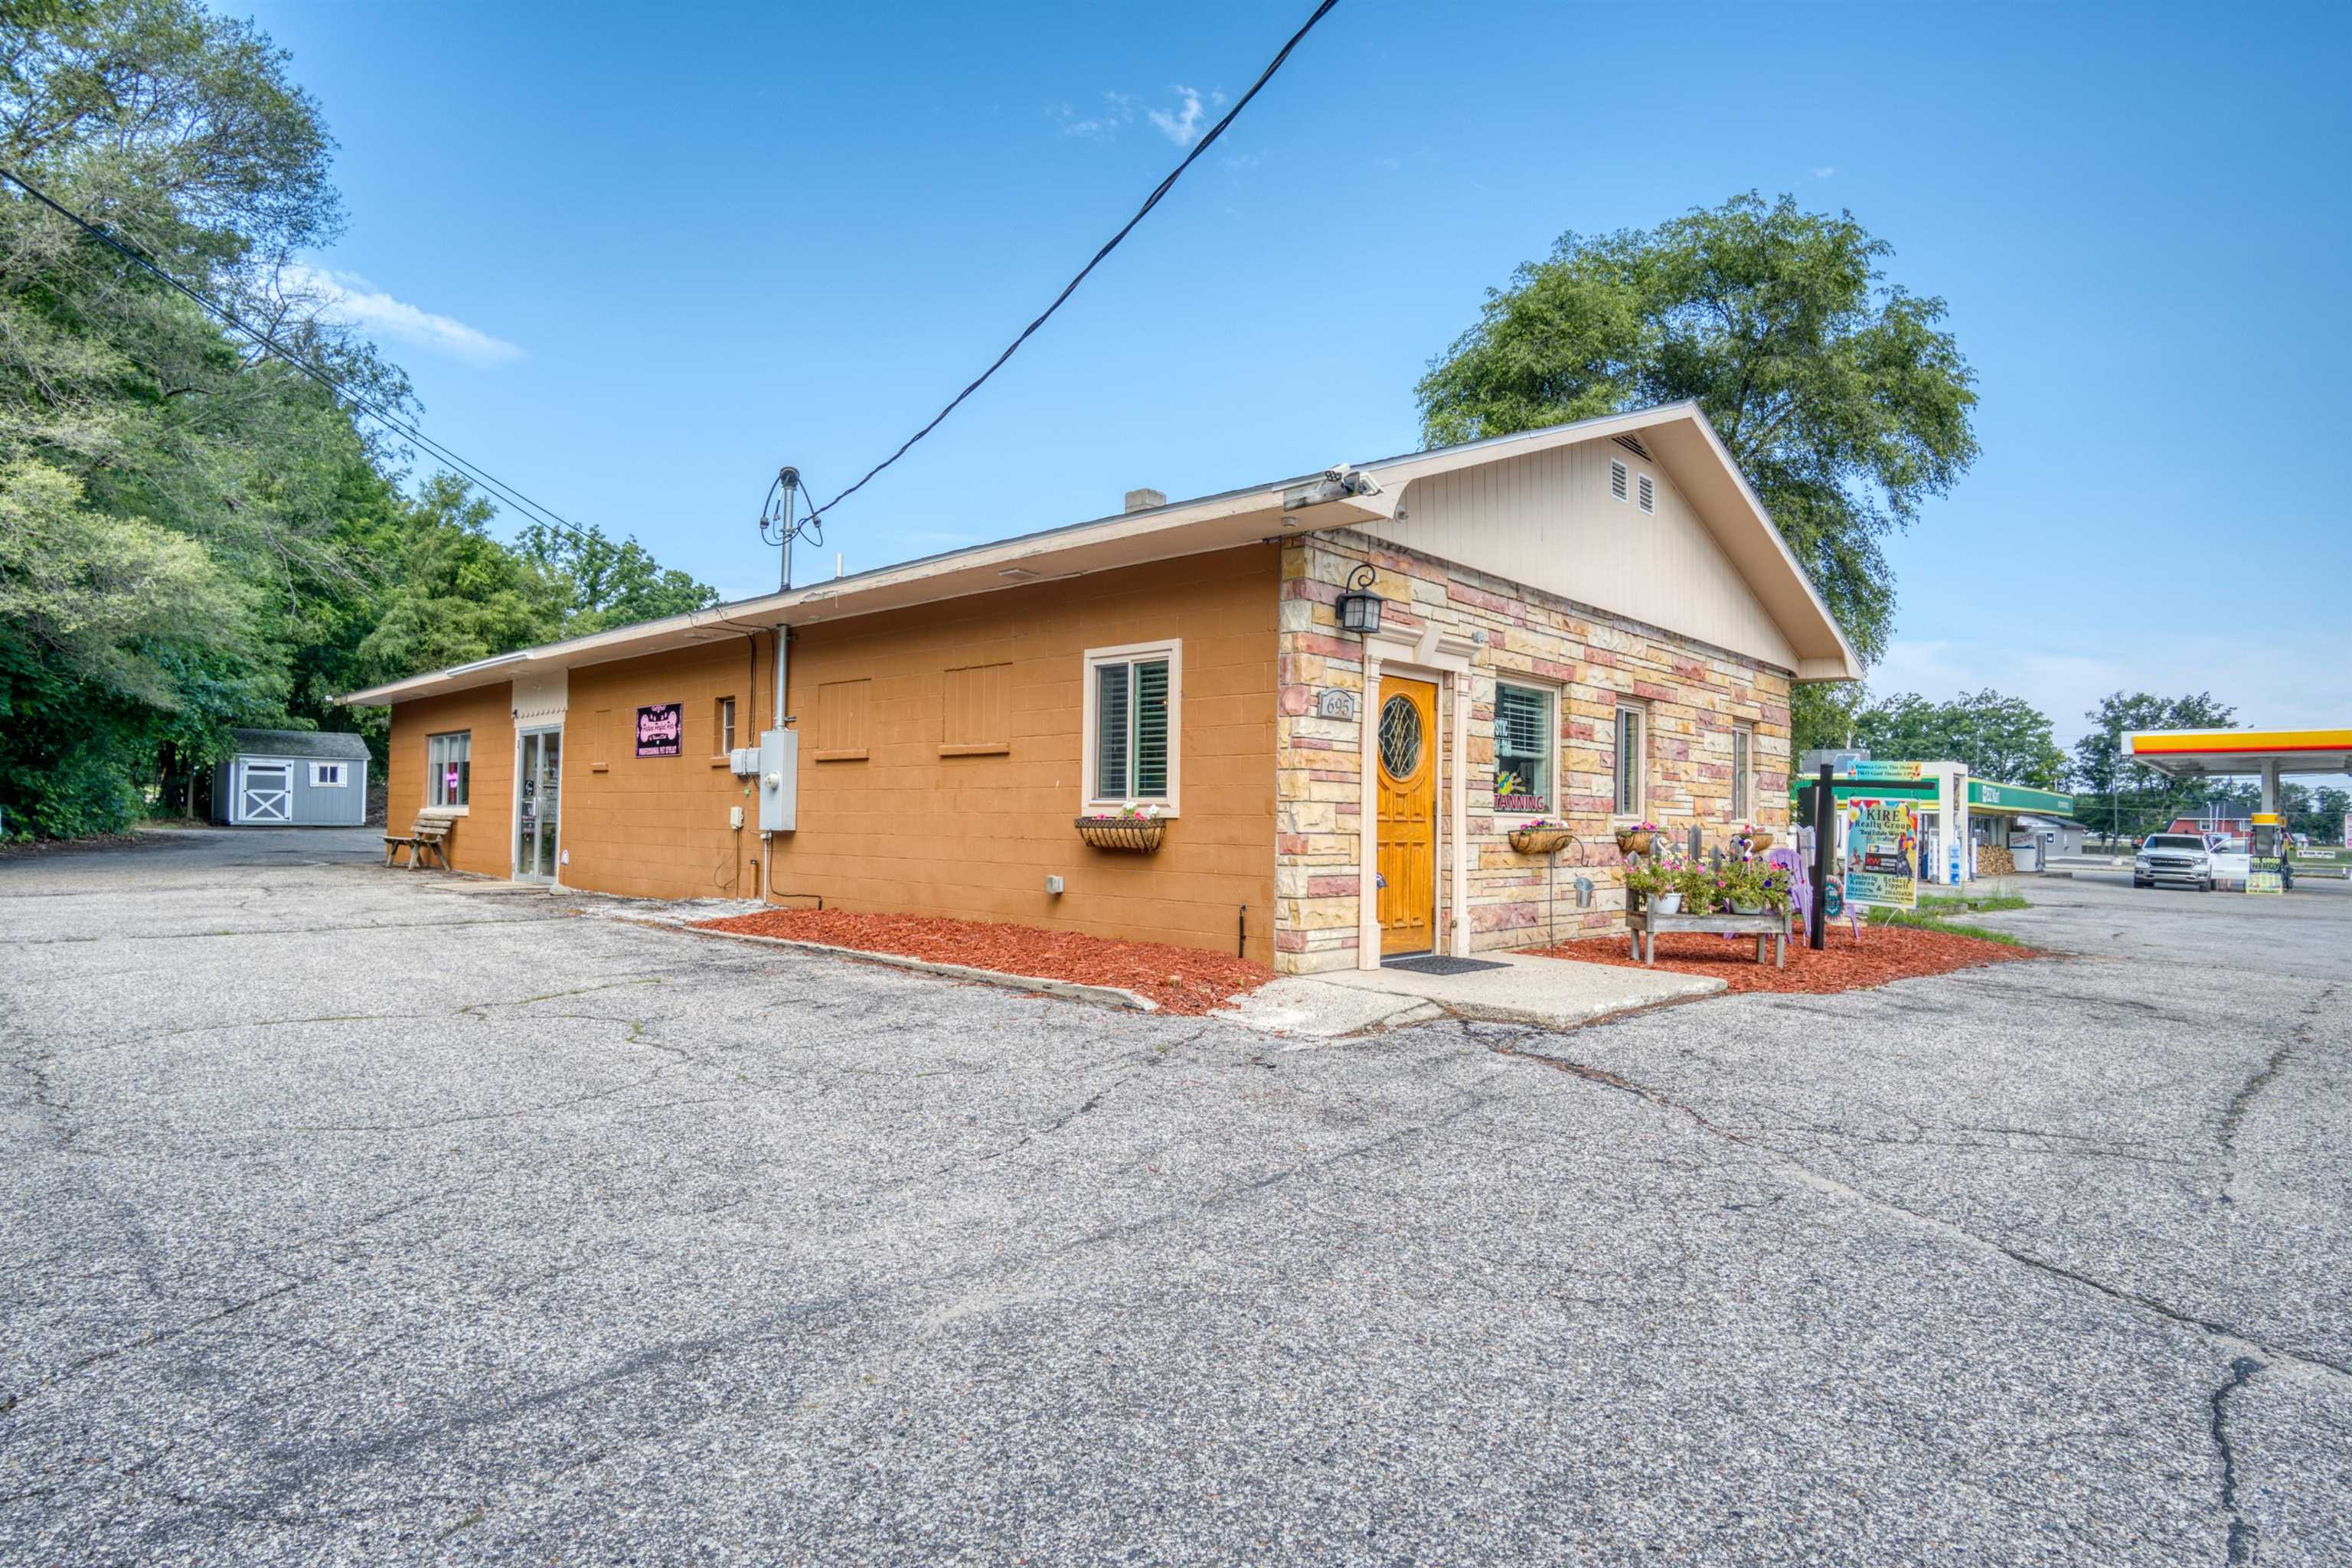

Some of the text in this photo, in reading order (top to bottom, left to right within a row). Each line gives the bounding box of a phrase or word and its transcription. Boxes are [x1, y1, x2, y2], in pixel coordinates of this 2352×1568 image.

[1327, 697, 1349, 716] 695
[1494, 793, 1544, 812] TANNING
[1867, 809, 1900, 822] KIRE
[1855, 820, 1912, 831] Realty Group
[1849, 874, 1878, 883] Kimberly
